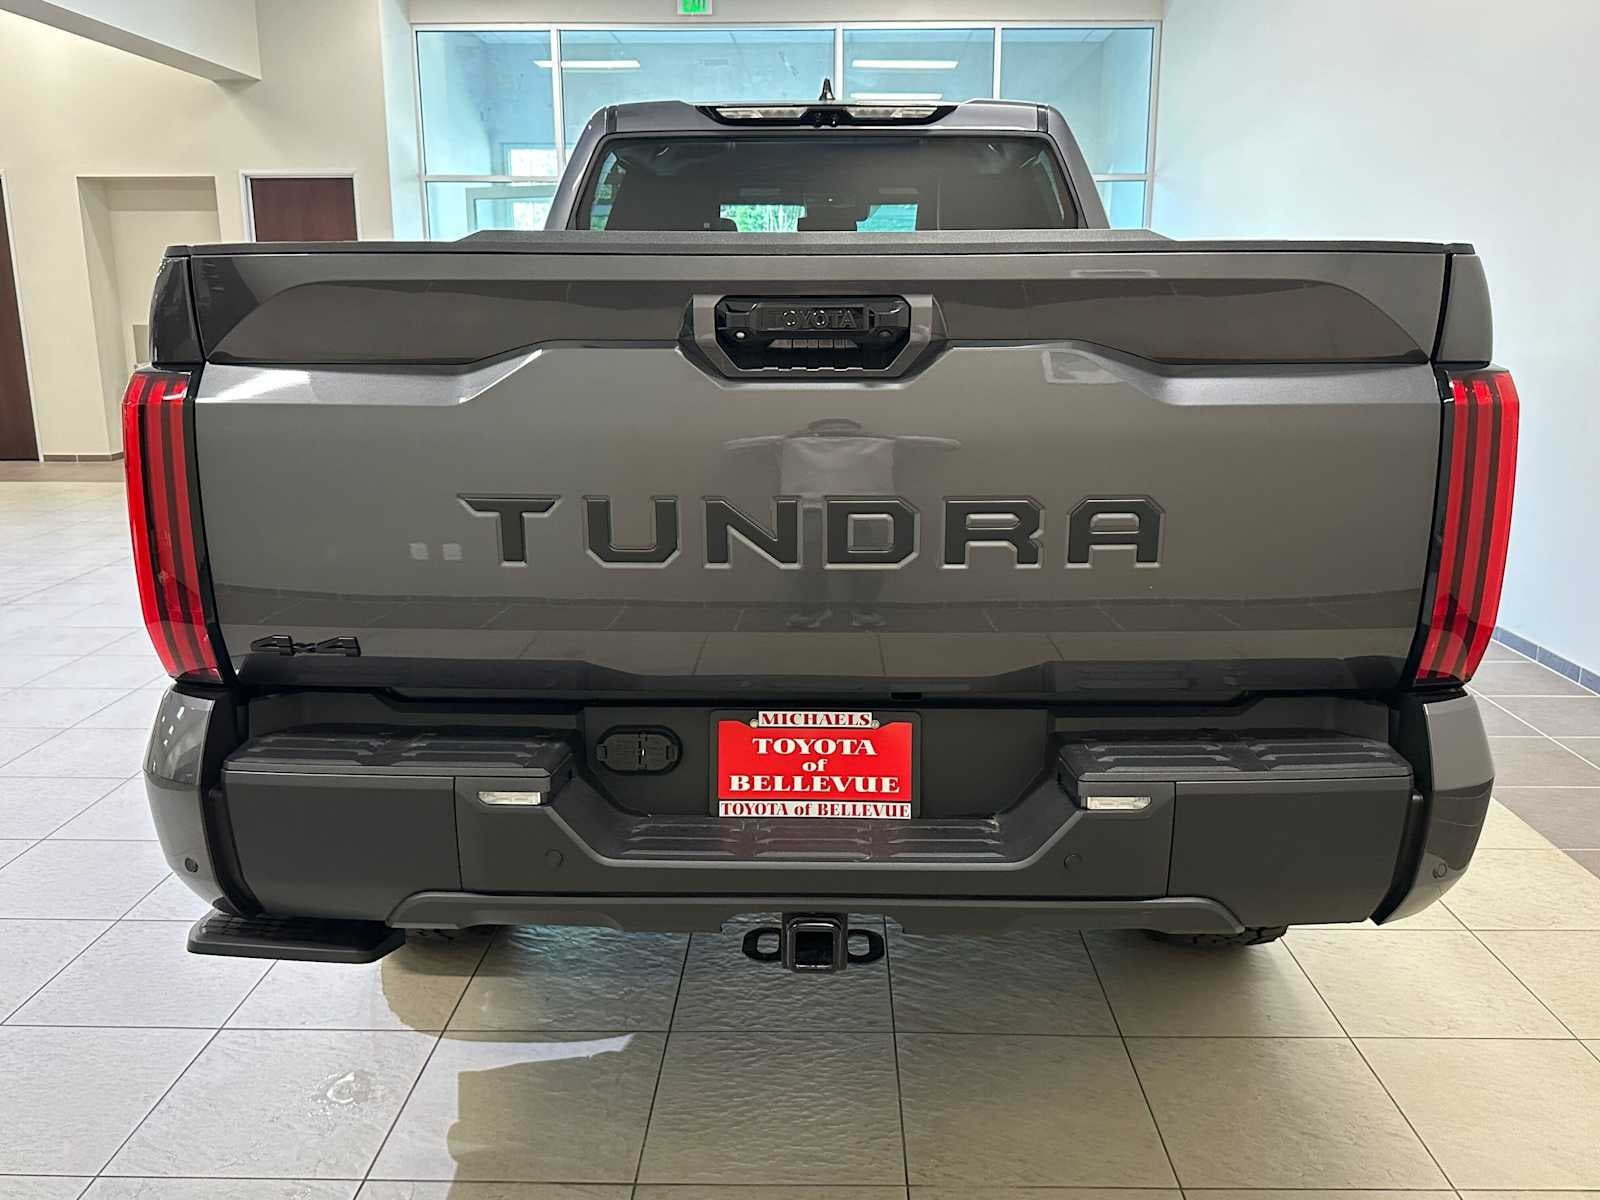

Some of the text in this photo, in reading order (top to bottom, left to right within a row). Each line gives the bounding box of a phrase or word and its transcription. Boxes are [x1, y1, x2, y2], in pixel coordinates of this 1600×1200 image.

[456, 494, 1166, 570] TUNDRA
[761, 713, 871, 726] MICHAELS
[752, 738, 877, 755] TOYOTA
[802, 758, 828, 773] of
[729, 775, 900, 793] BELLEVUE
[721, 802, 910, 817] TOYOTA of BELLEVUE
